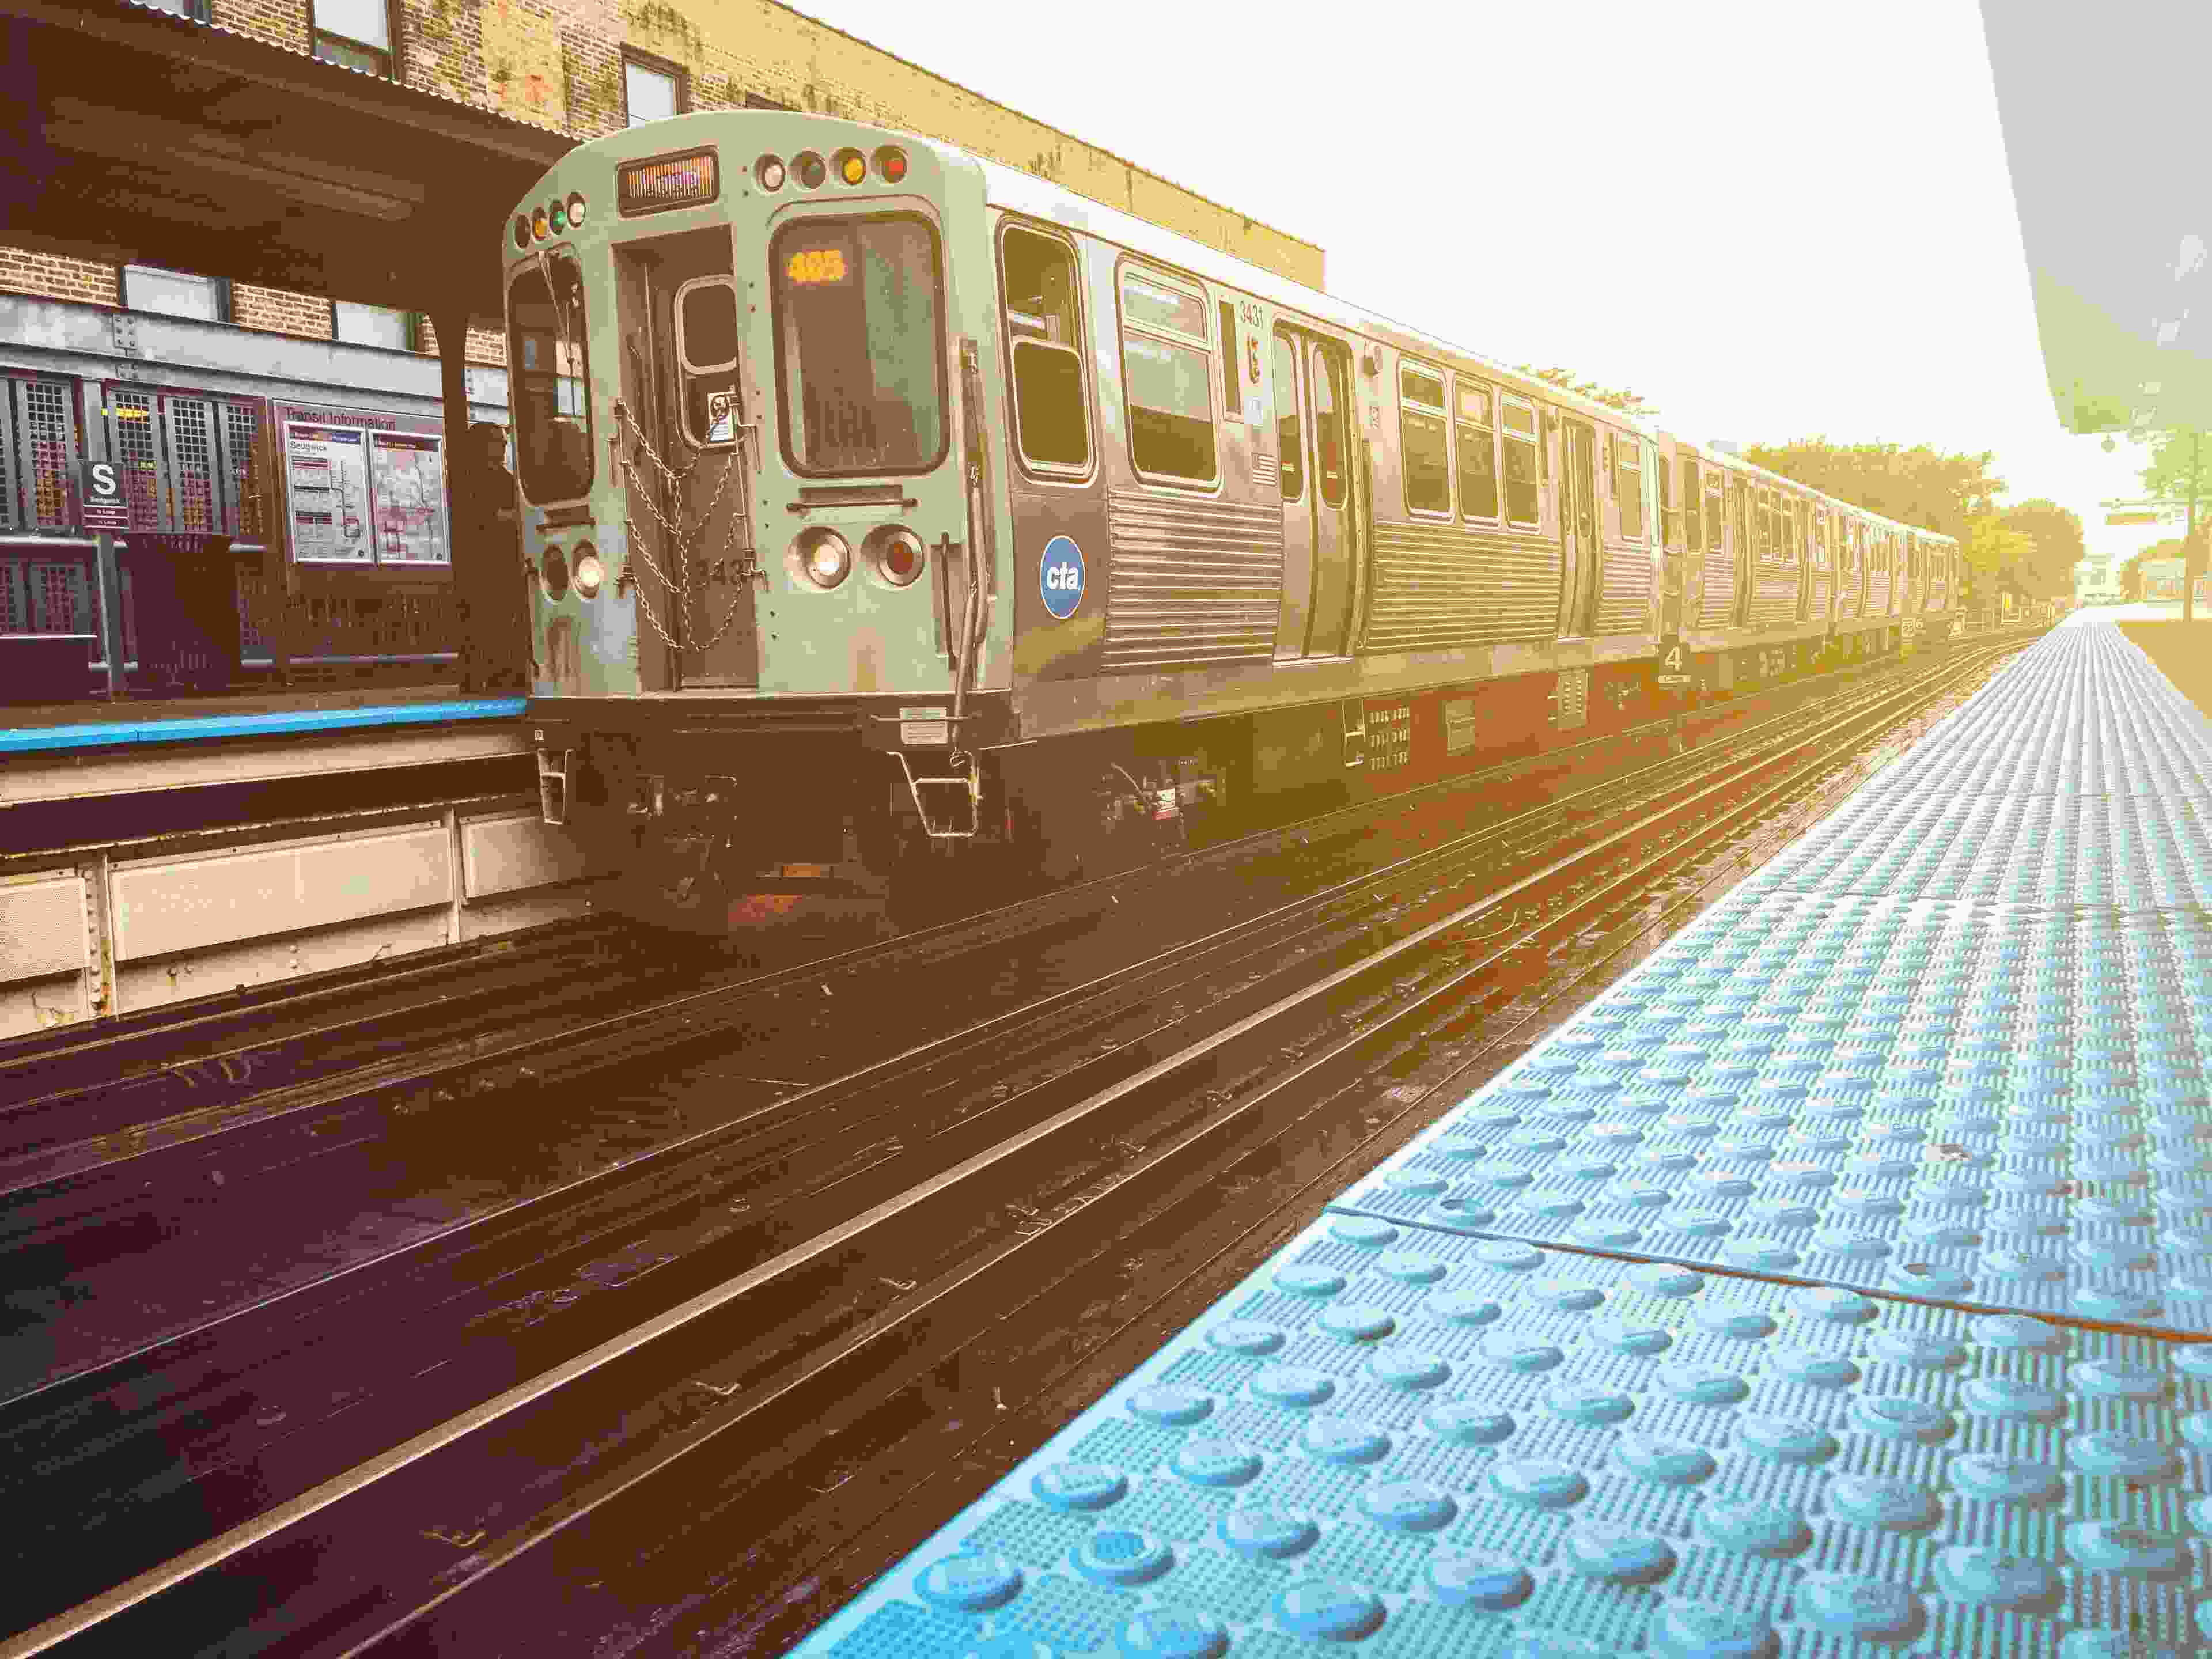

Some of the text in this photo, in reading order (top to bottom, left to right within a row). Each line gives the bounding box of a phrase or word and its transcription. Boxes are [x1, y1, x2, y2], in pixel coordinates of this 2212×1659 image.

[1240, 300, 1263, 329] 3431
[283, 407, 396, 431] Transit Information
[92, 464, 116, 495] S
[1047, 562, 1079, 590] cta
[1664, 646, 1683, 672] 4
